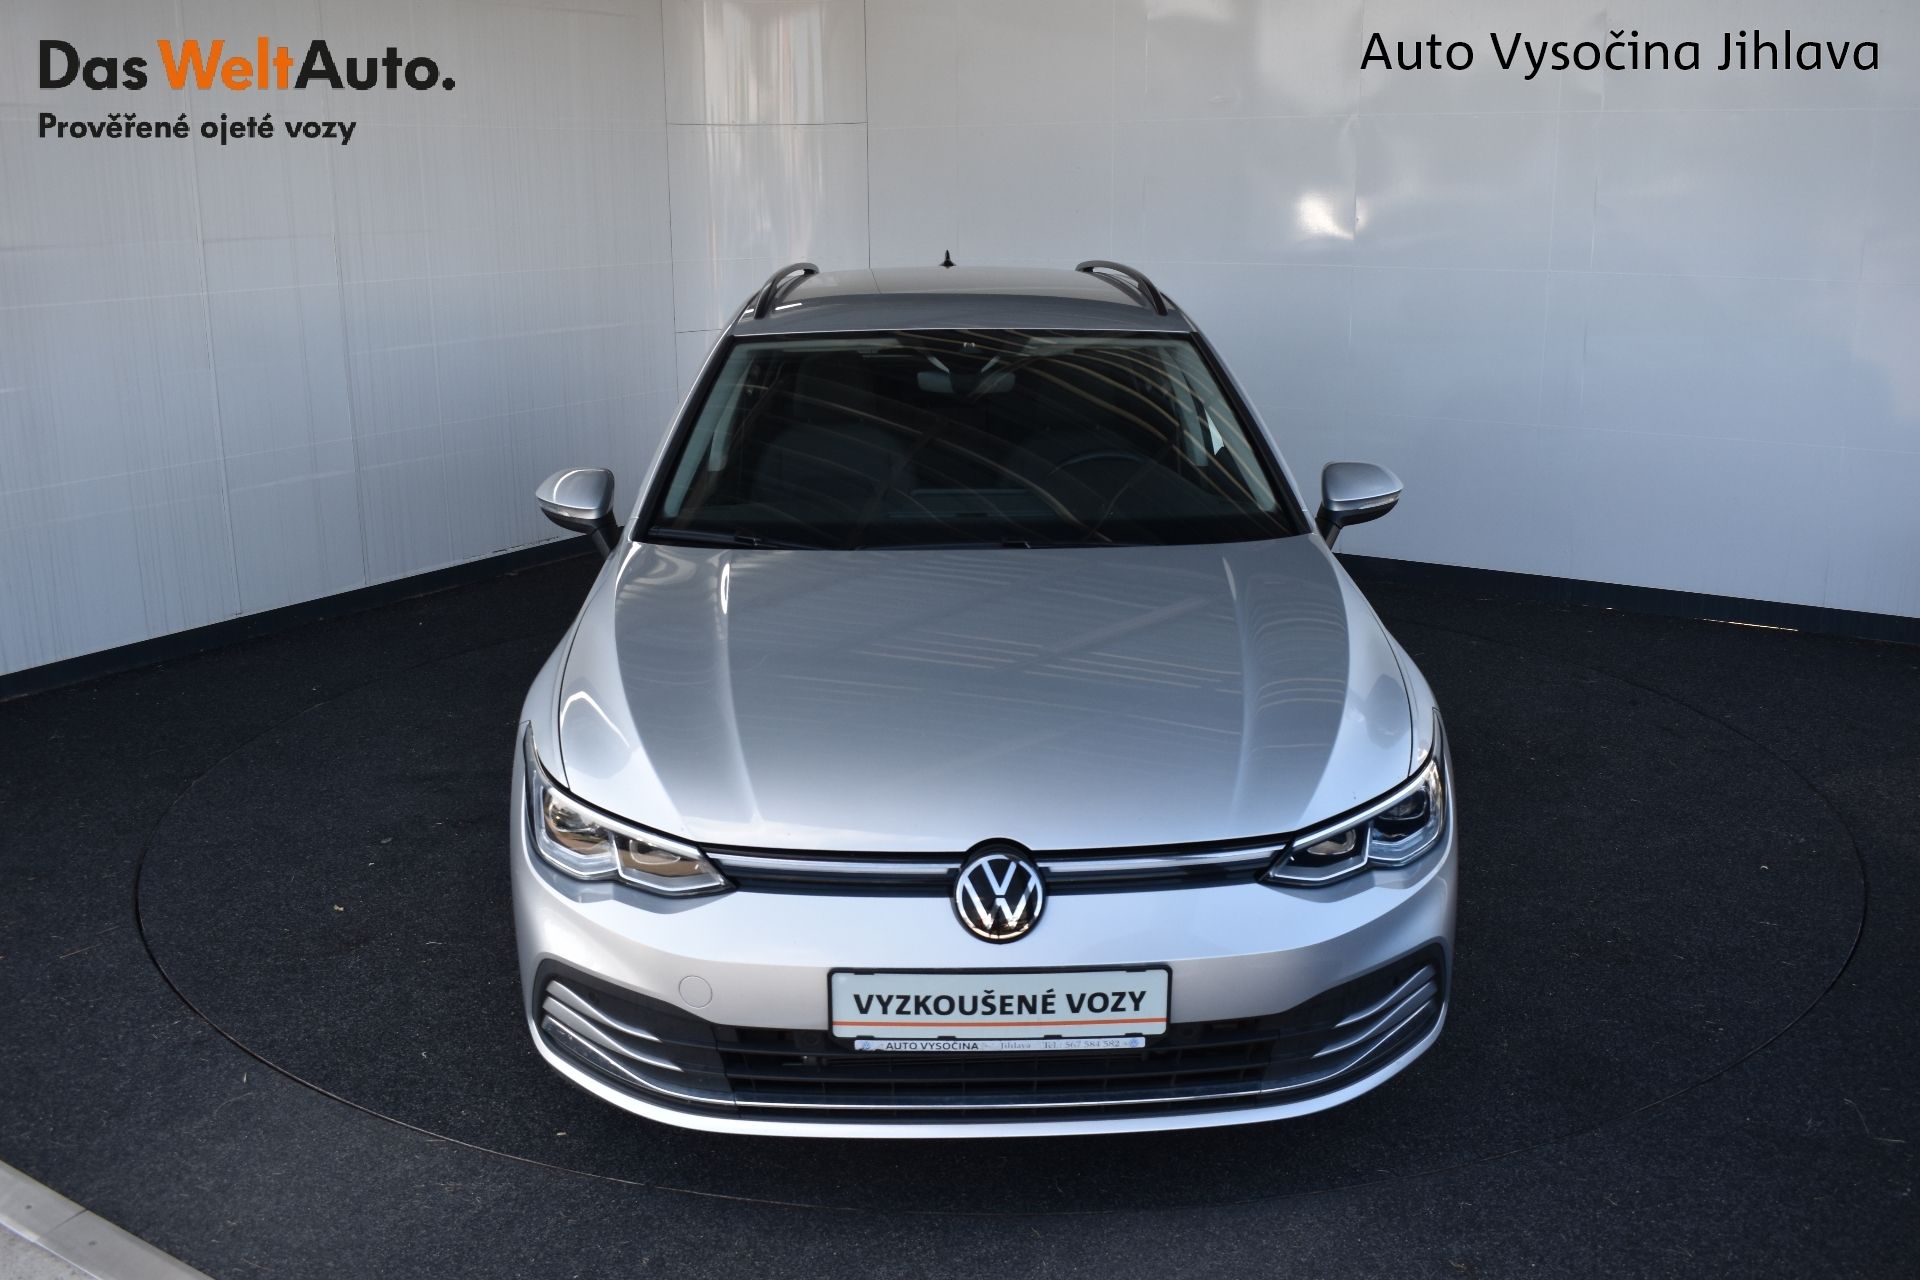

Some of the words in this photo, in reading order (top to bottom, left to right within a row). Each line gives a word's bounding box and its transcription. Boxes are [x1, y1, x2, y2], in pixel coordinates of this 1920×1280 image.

[853, 988, 1057, 1016] VYZKOUŠENÉ
[1065, 990, 1147, 1014] VOZY
[885, 1042, 918, 1050] AUTO
[1103, 1039, 1120, 1047] 582
